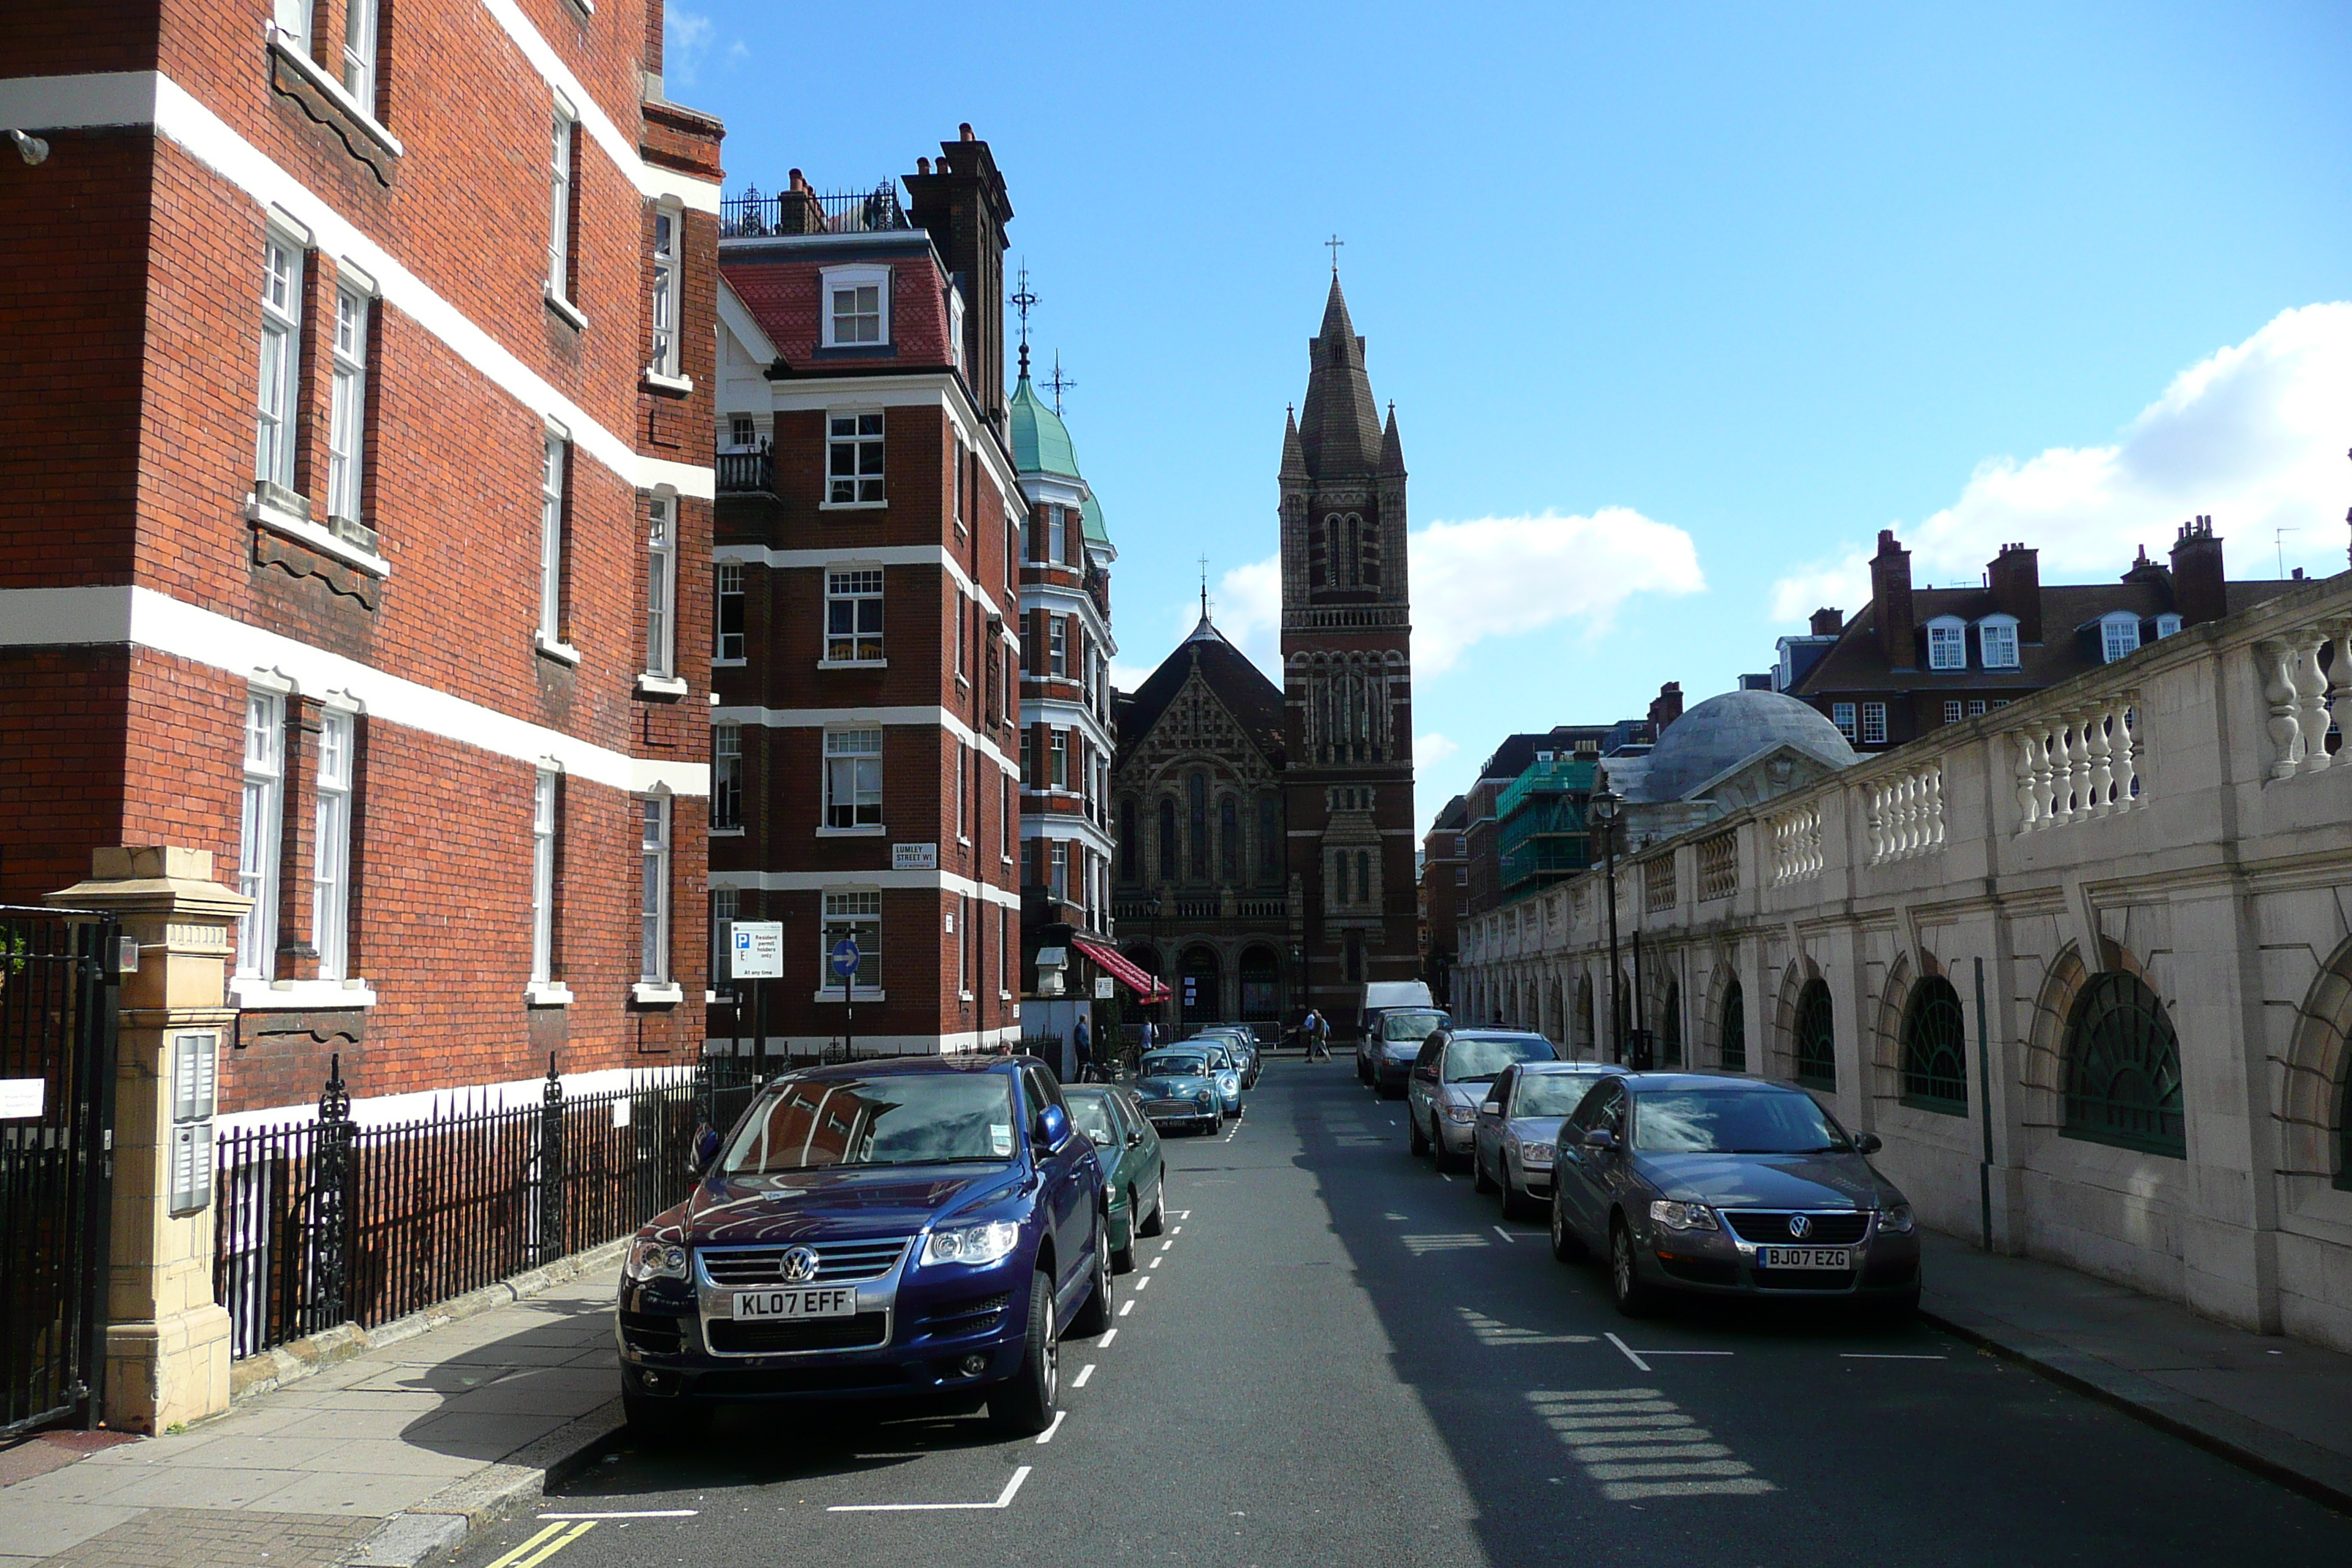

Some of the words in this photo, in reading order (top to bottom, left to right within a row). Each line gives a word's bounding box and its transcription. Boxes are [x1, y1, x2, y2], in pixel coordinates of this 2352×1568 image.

[897, 853, 920, 862] STREET
[737, 934, 748, 948] P
[740, 950, 745, 961] E
[1770, 1249, 1811, 1265] BJ07
[1814, 1251, 1845, 1266] EZG
[742, 1292, 798, 1316] KL07
[804, 1290, 847, 1313] EFF
